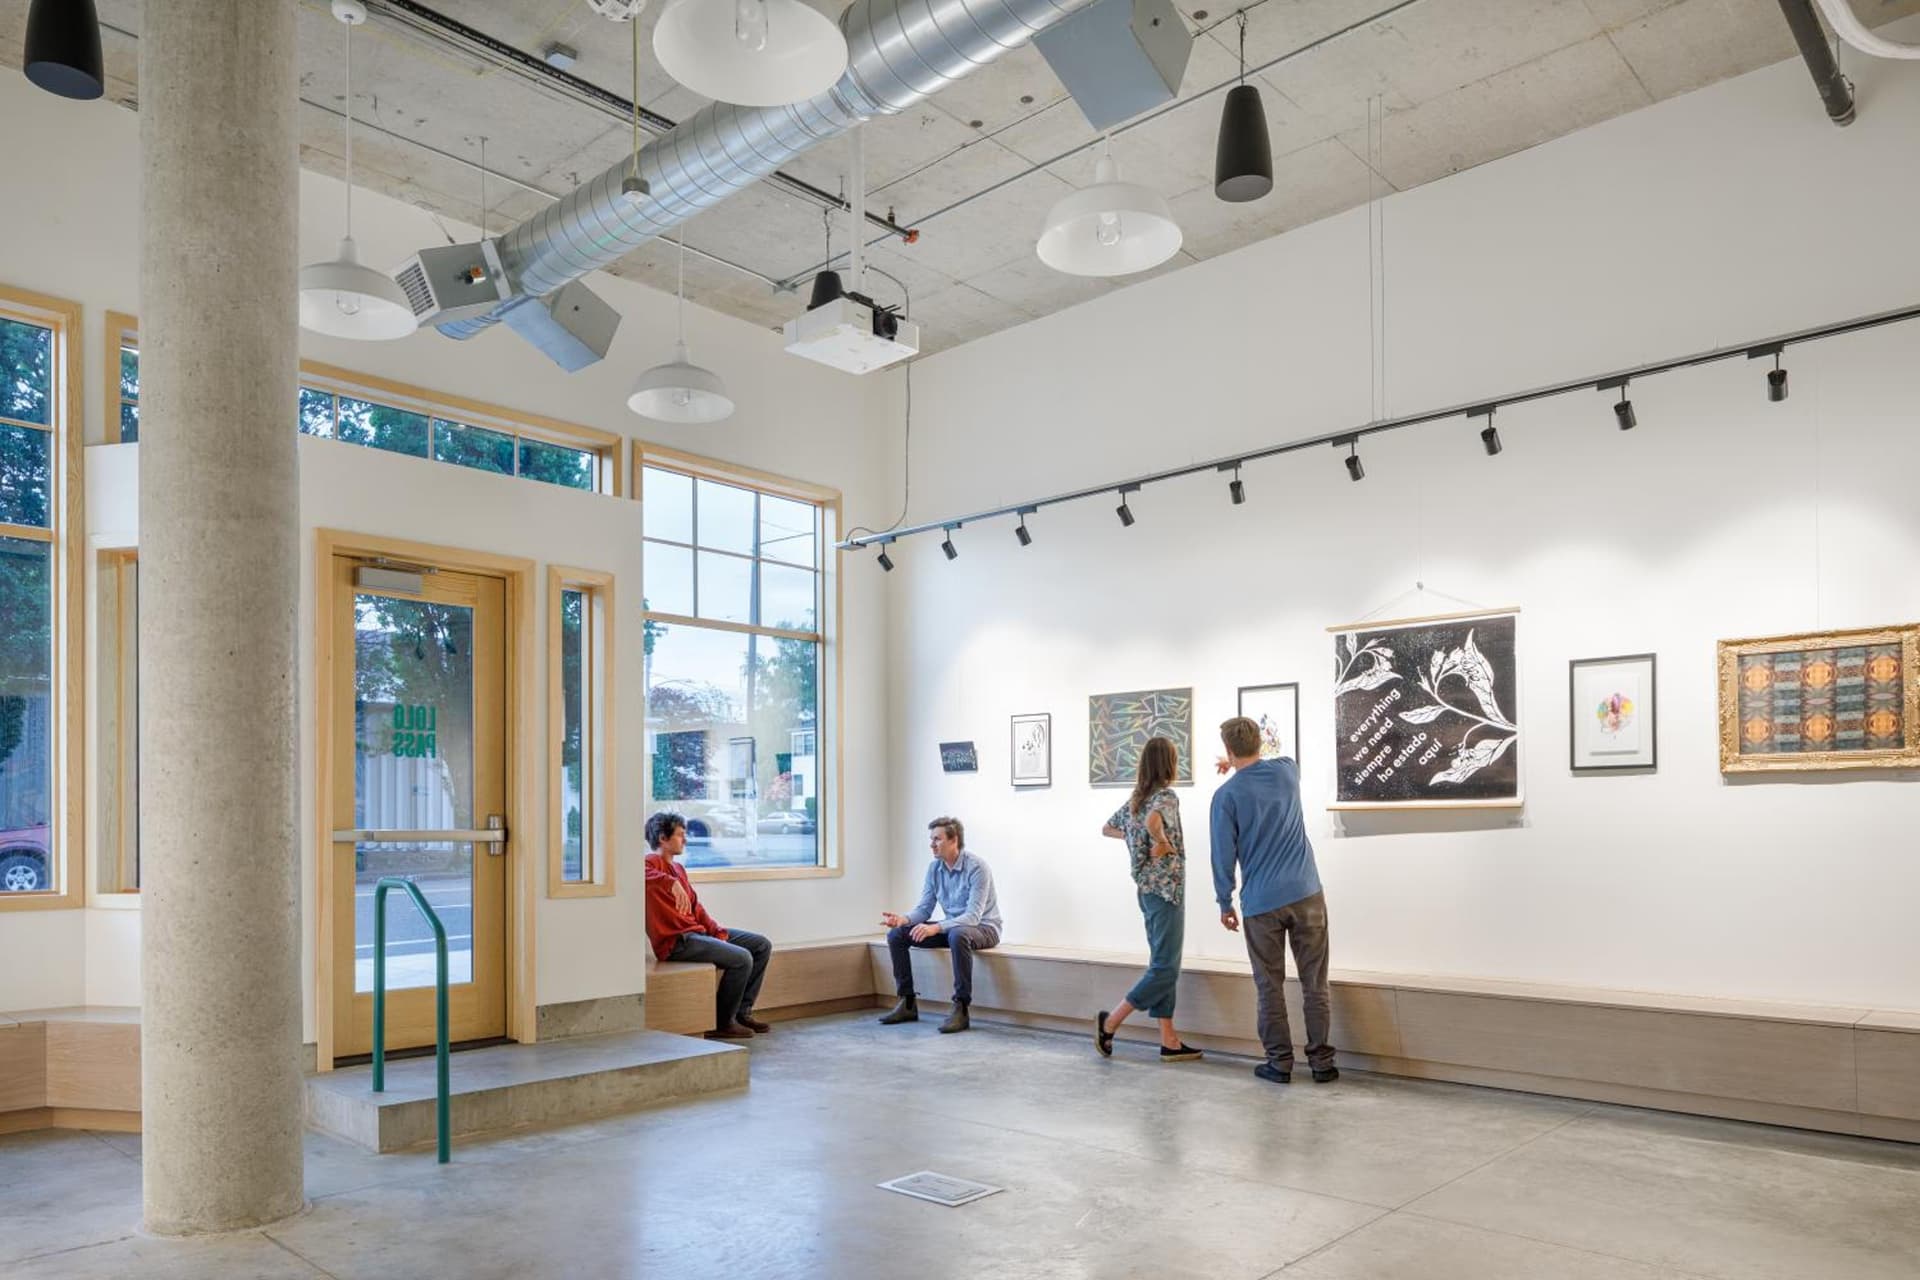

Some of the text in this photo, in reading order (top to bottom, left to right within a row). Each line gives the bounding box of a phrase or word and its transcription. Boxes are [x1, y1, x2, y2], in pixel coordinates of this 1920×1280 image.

[1350, 688, 1401, 743] everything
[1353, 717, 1394, 762] we need
[1354, 745, 1392, 785] siempre
[1377, 732, 1427, 783] ha estado
